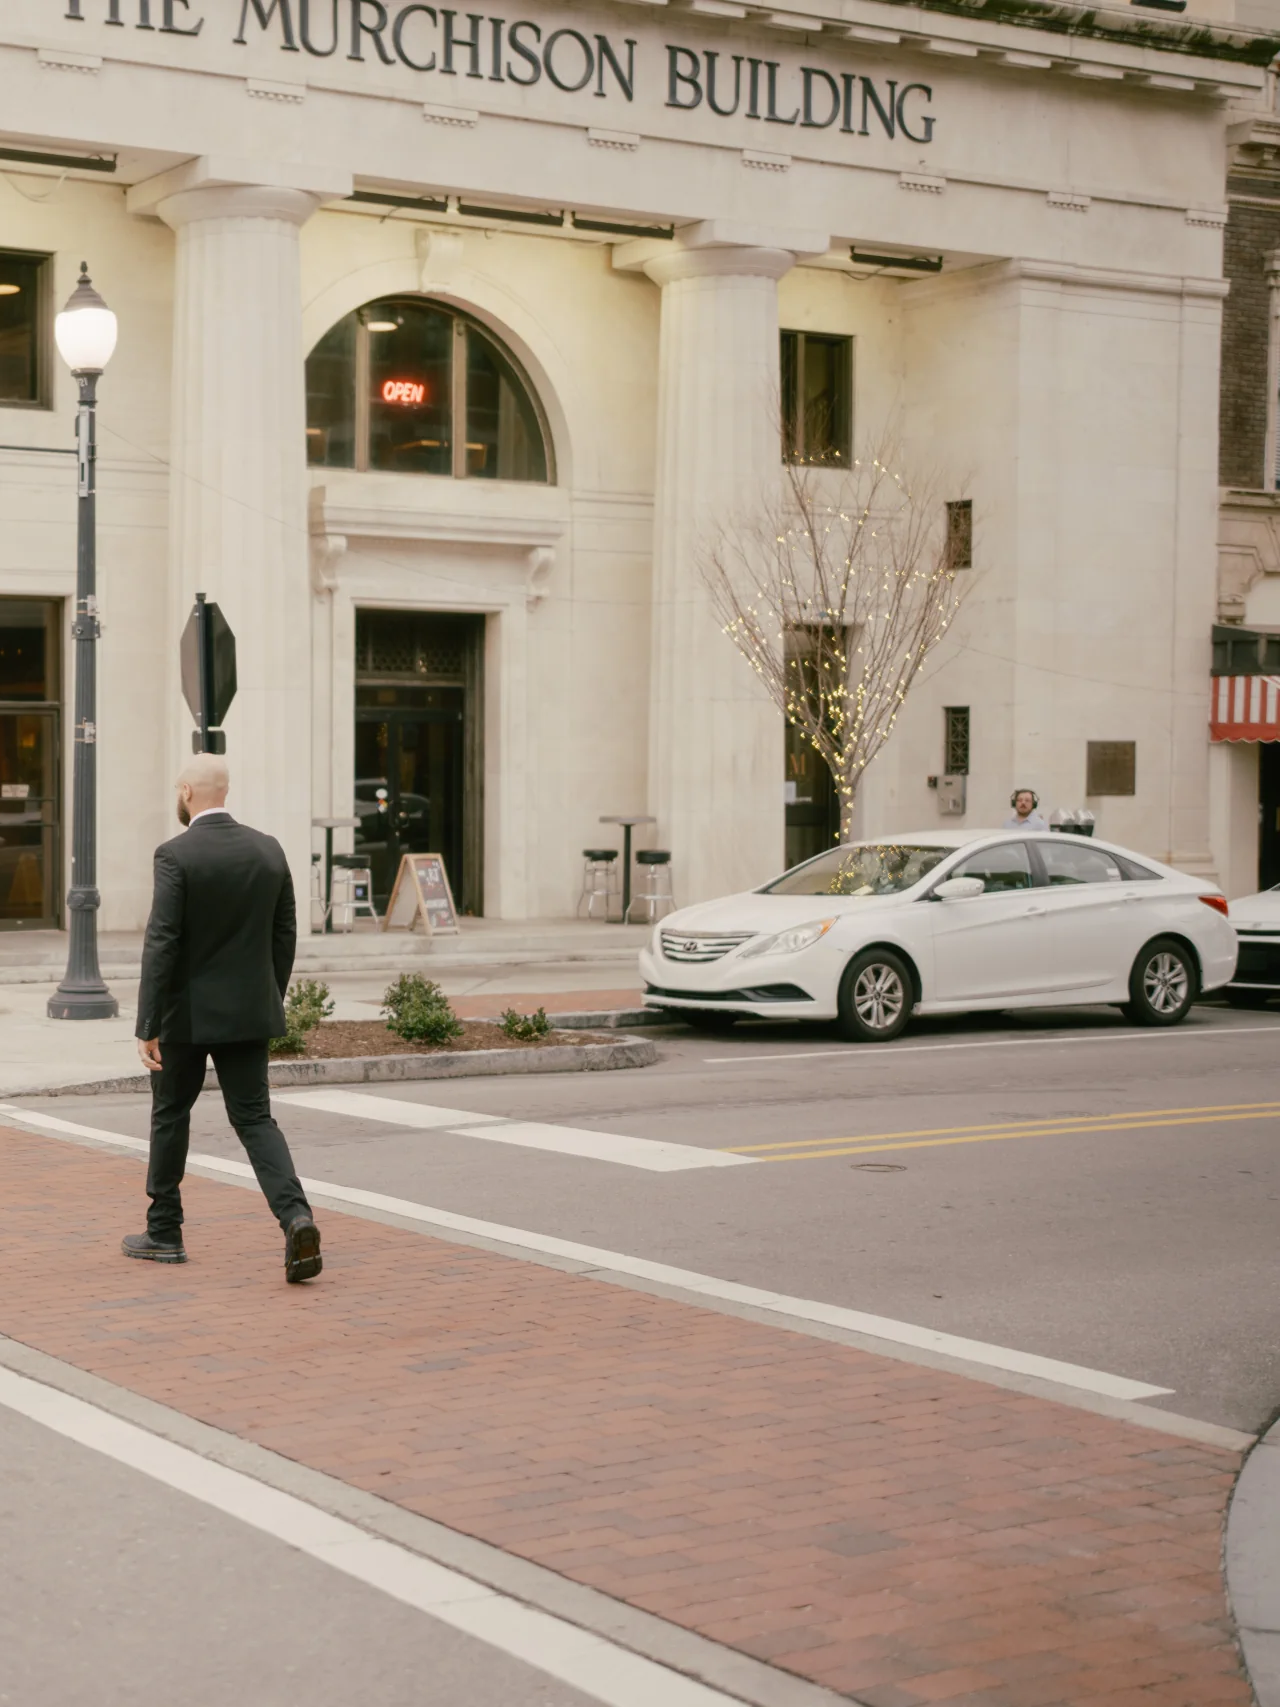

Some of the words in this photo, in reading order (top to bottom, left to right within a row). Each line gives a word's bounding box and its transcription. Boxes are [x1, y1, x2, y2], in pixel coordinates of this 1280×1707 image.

[233, 0, 638, 102] MURCHISON
[664, 44, 937, 144] BUILDING
[383, 380, 425, 403] OPEN
